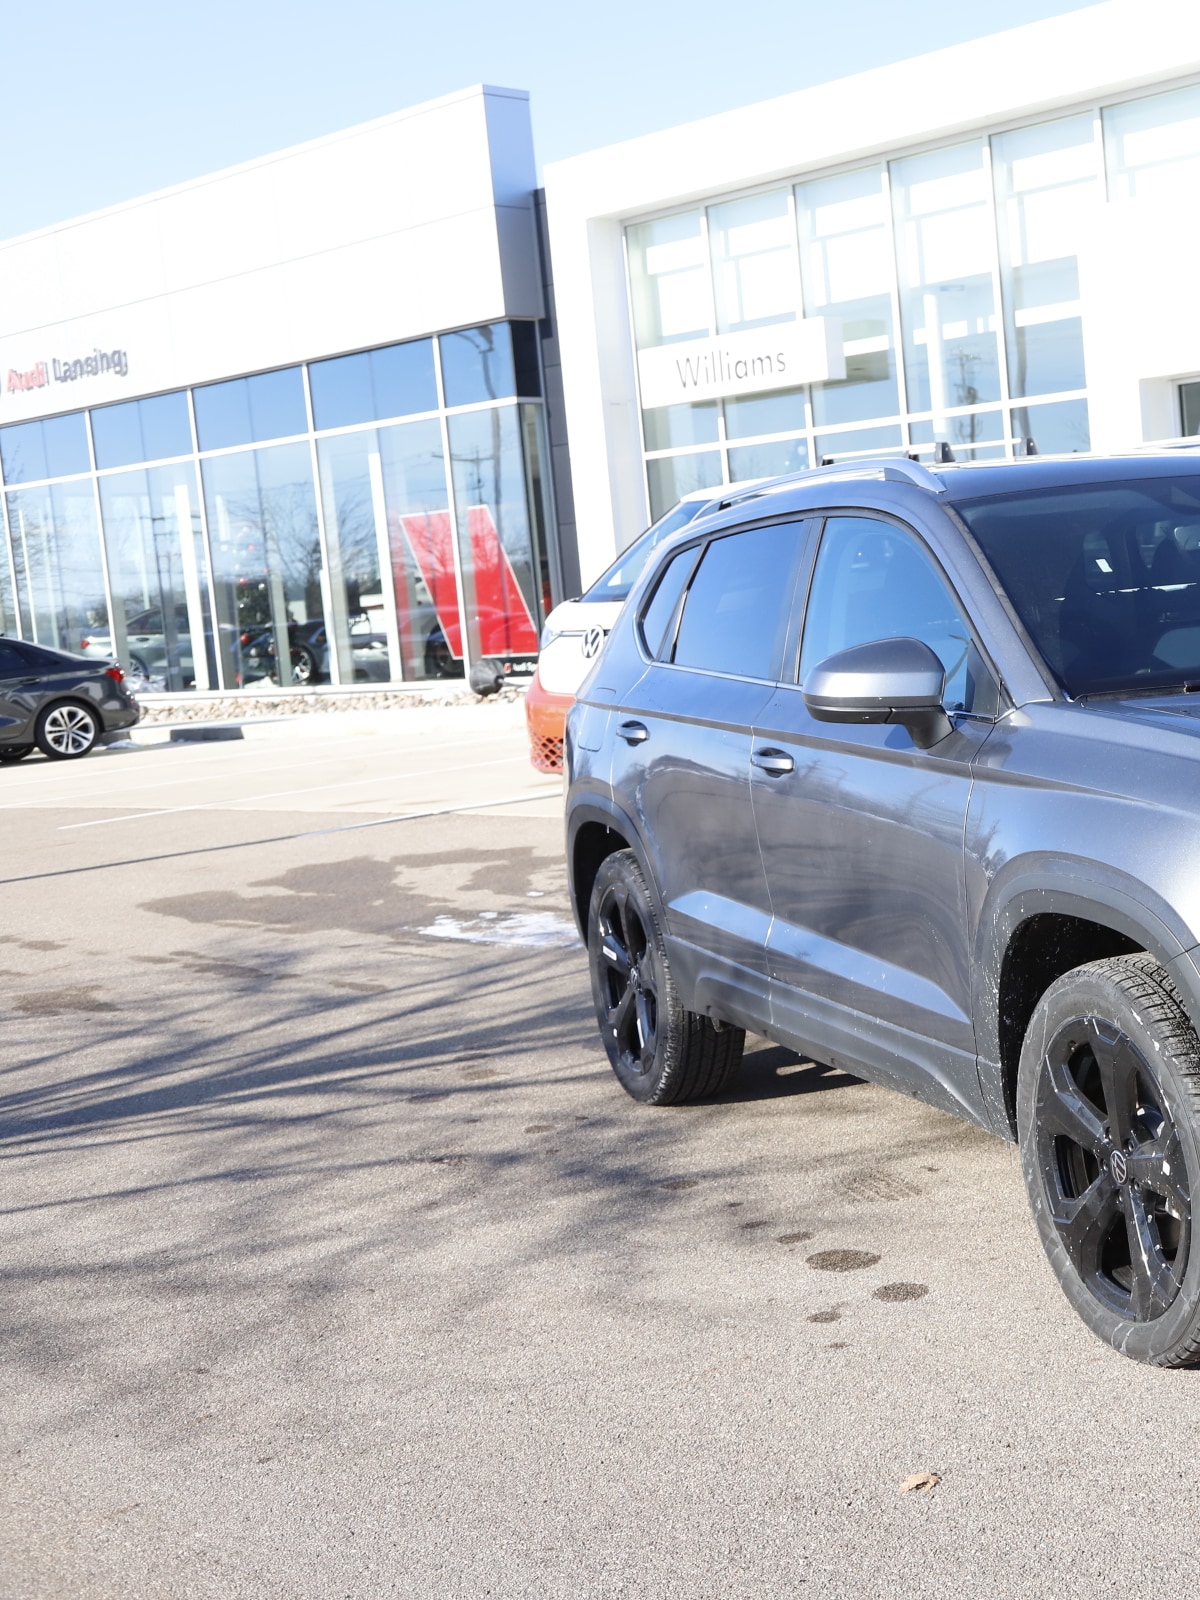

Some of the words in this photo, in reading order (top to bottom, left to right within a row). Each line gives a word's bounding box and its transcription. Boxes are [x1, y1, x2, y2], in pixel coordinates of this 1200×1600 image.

[7, 361, 48, 393] Audi
[52, 348, 128, 377] Lansing
[676, 350, 786, 388] Williams
